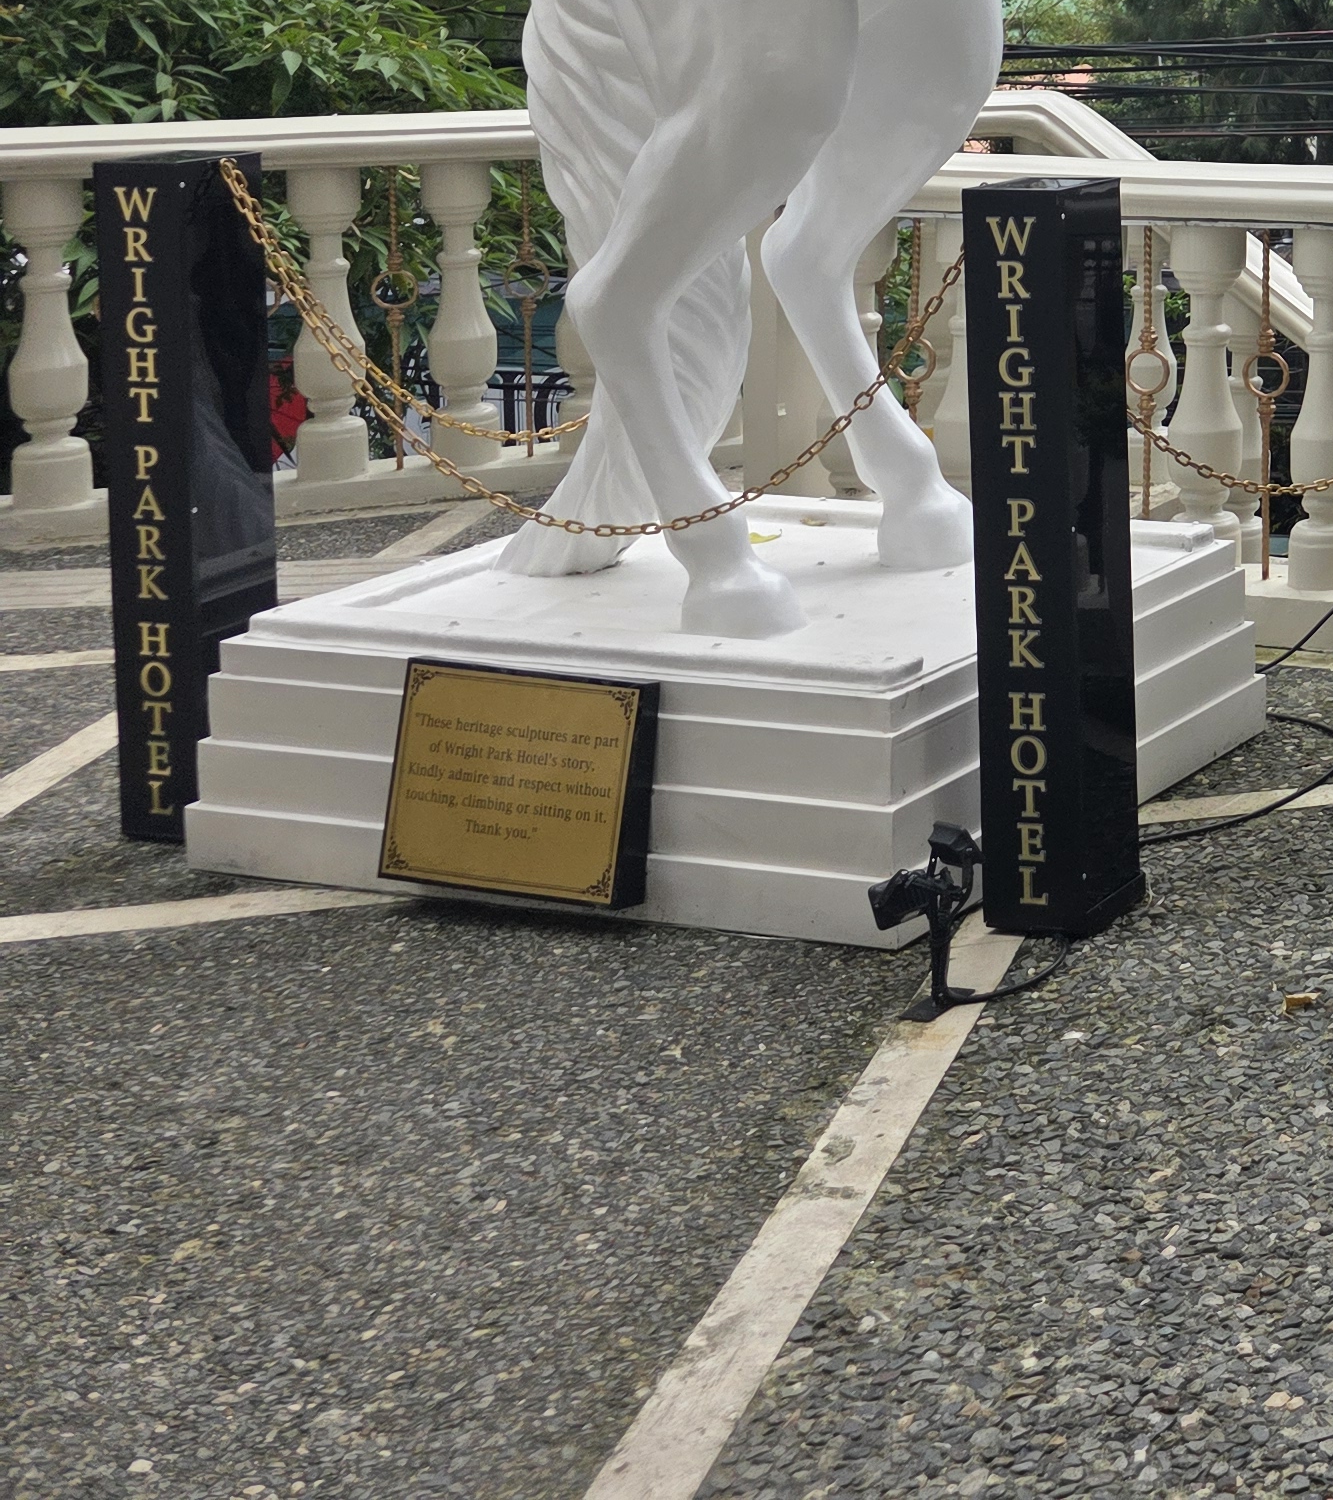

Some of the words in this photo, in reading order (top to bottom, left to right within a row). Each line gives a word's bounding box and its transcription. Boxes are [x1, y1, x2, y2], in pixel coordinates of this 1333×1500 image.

[114, 185, 159, 424] WRIGHT
[986, 216, 1036, 475] WRIGHT
[134, 444, 166, 600] PARK
[1004, 499, 1043, 670] PARK
[138, 620, 173, 814] HOTEL
[407, 762, 444, 780] Kindly
[447, 769, 488, 785] admire
[492, 774, 514, 787] and
[518, 778, 561, 793] respect
[564, 782, 610, 798] without
[414, 712, 452, 730] "These
[455, 717, 502, 737] heritage
[506, 725, 568, 742] sculptures
[570, 732, 590, 744] are
[593, 736, 618, 750] part
[428, 740, 441, 752] of
[444, 742, 482, 760] Wright
[486, 747, 512, 762] Park
[516, 752, 558, 767] Hotel's
[405, 788, 458, 807] touching,
[460, 794, 512, 814] climbing
[516, 803, 530, 815] or
[532, 806, 572, 821] sitting
[574, 810, 590, 822] on
[593, 811, 607, 824] it.
[464, 819, 502, 835] Thank
[504, 828, 538, 840] you."
[1009, 692, 1049, 906] HOTEL
